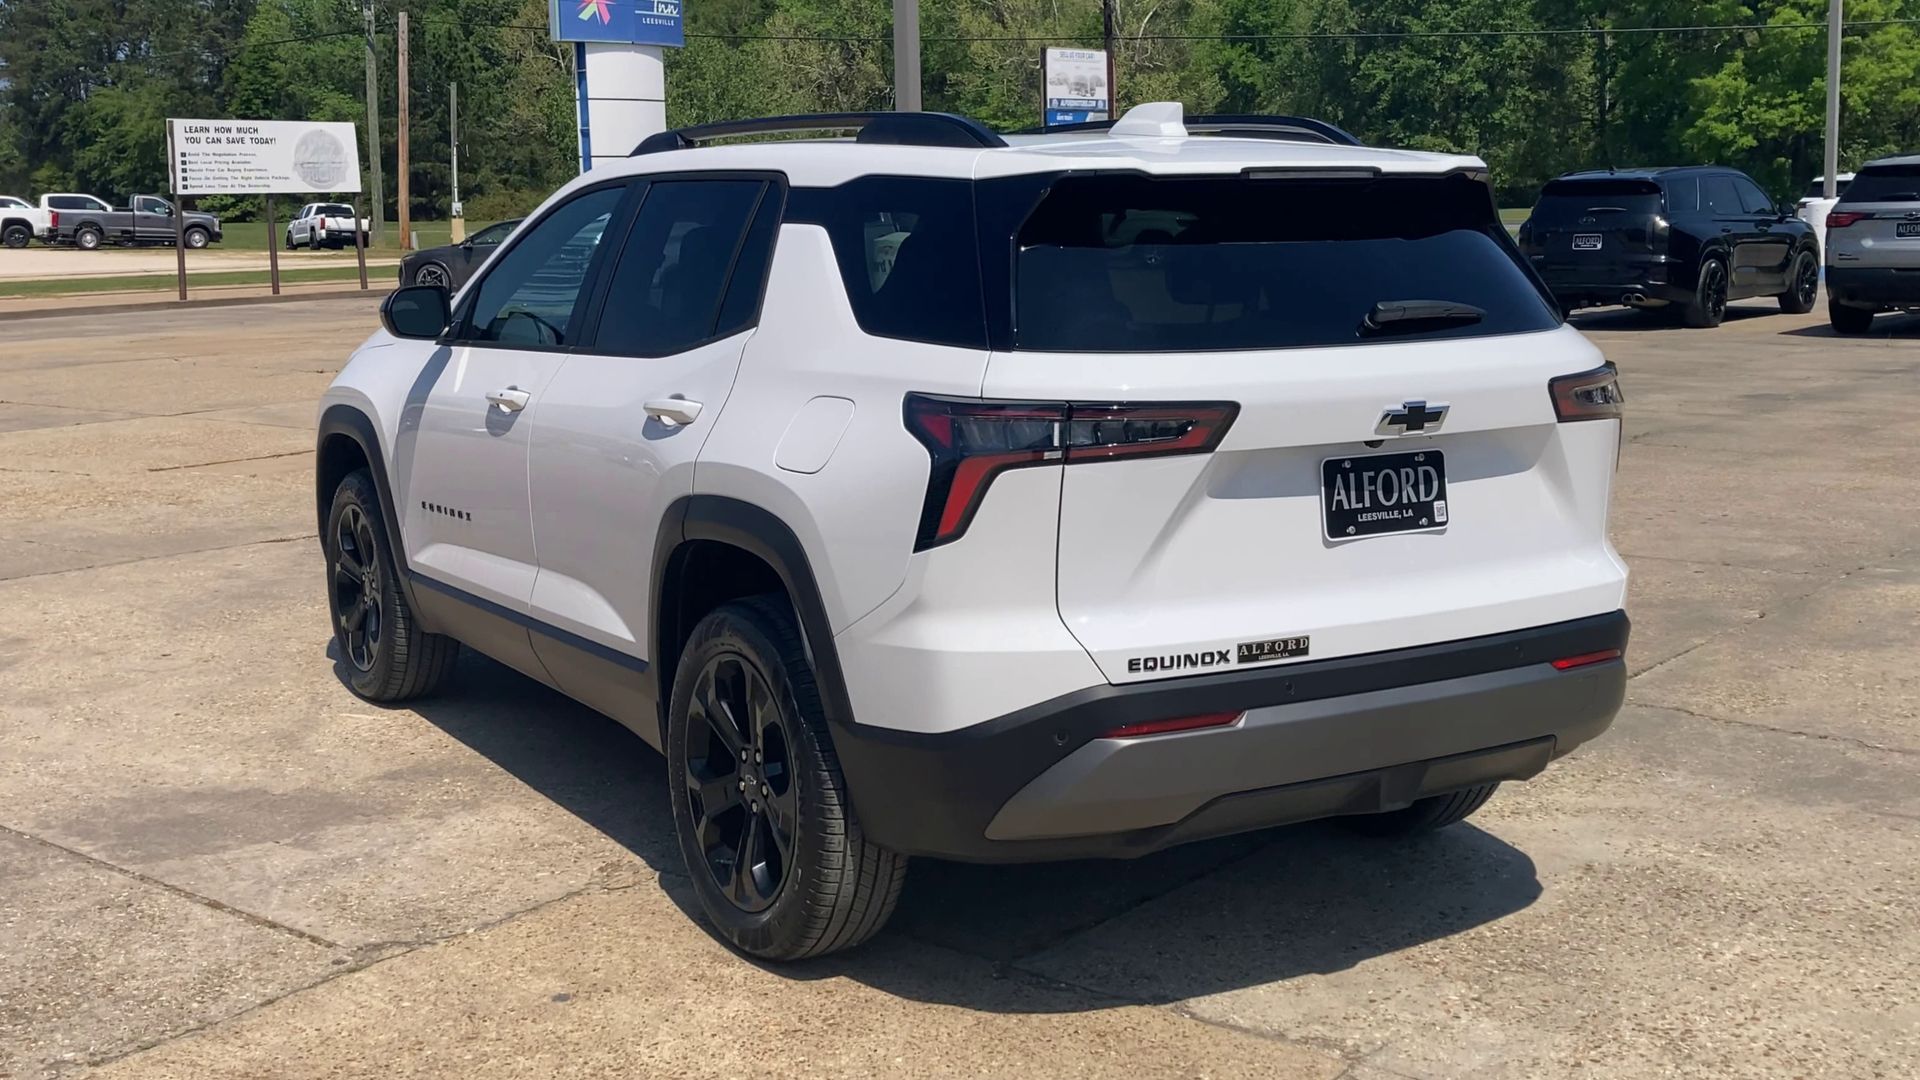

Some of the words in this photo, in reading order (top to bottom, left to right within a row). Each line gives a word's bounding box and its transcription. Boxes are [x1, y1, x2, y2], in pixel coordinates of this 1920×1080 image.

[642, 17, 675, 26] LEESVILLE
[185, 136, 201, 144] YOU
[1331, 466, 1439, 511] ALFORD
[1358, 510, 1401, 521] LEESVILLE,
[1403, 509, 1414, 517] LA
[1240, 638, 1308, 656] ALFORD
[1128, 650, 1231, 673] EQUINOX
